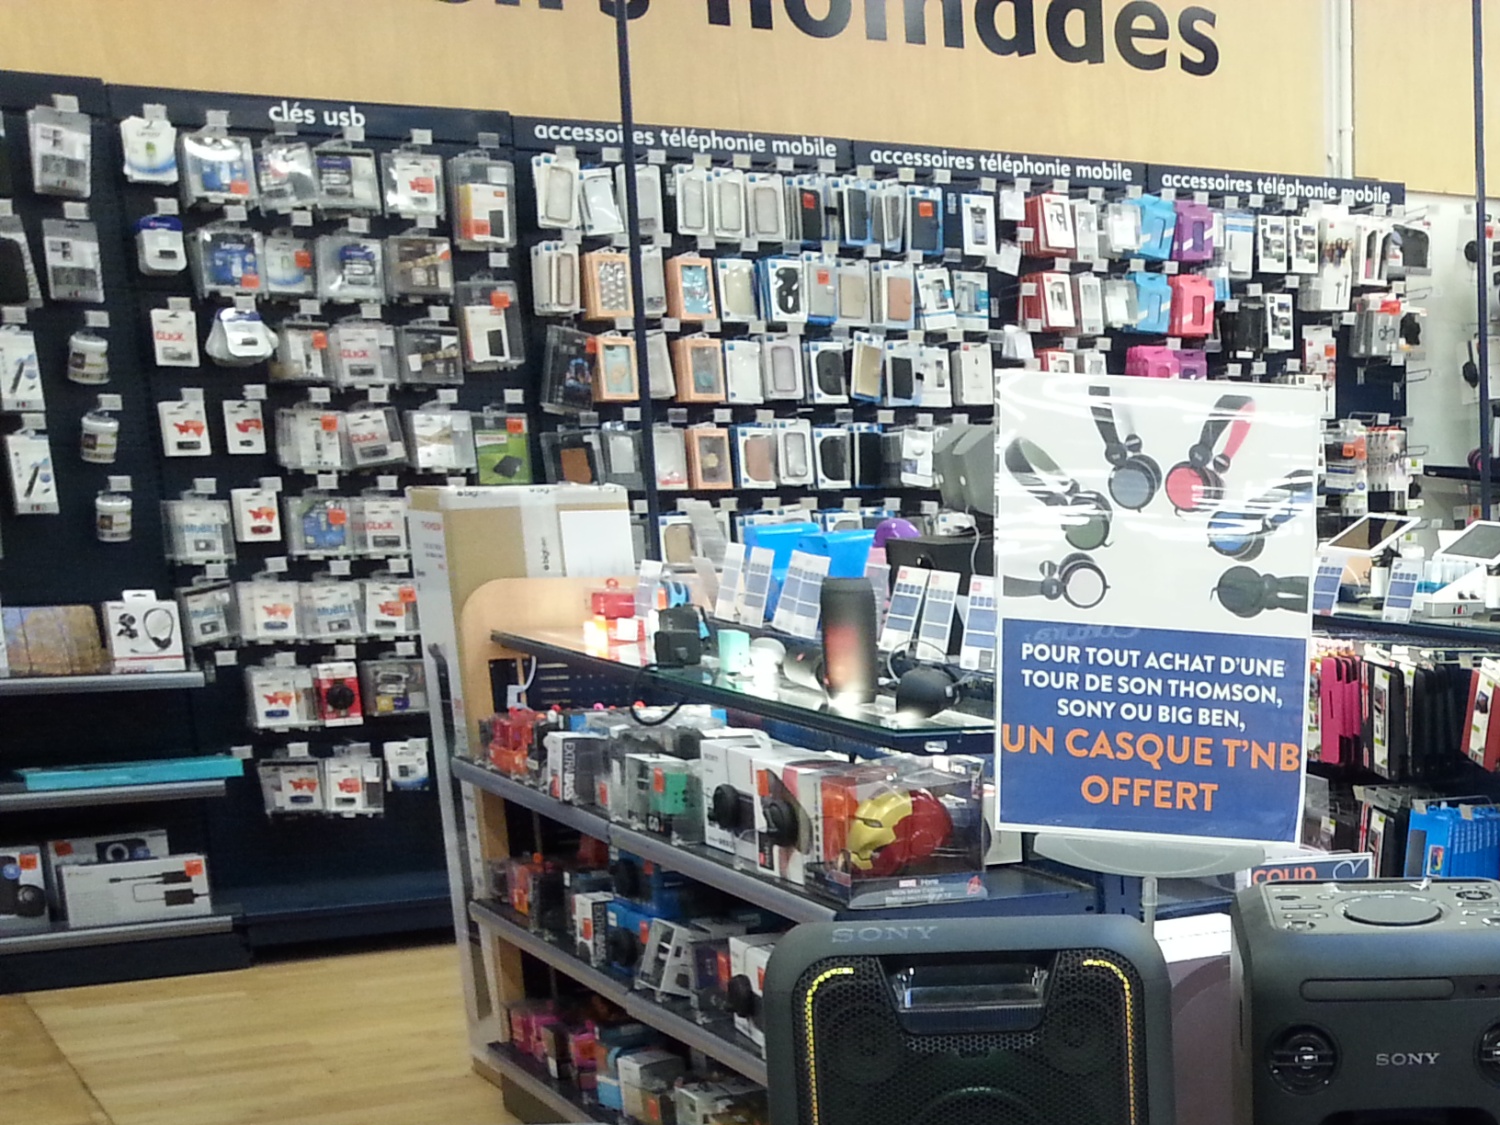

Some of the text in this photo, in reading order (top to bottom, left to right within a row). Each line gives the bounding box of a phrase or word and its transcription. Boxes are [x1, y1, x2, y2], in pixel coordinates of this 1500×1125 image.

[268, 100, 366, 128] clés usb
[534, 123, 838, 158] accessoies téléphonie mobile
[870, 146, 1132, 182] accessoires téléphonie mobile
[1161, 171, 1391, 205] accessoires téléphonie mobile
[1021, 642, 1285, 678] POUR TOUT ACHAT D'UNE
[1021, 669, 1283, 708] TOUR DE SON THOMSON,
[1057, 698, 1246, 732] SONY OU BIG BEN,
[1002, 723, 1300, 772] UN CASQUE T'NB
[1081, 775, 1219, 812] OFFERT
[1252, 865, 1317, 886] coup
[832, 926, 938, 943] SONY
[1376, 1053, 1440, 1067] SONY
